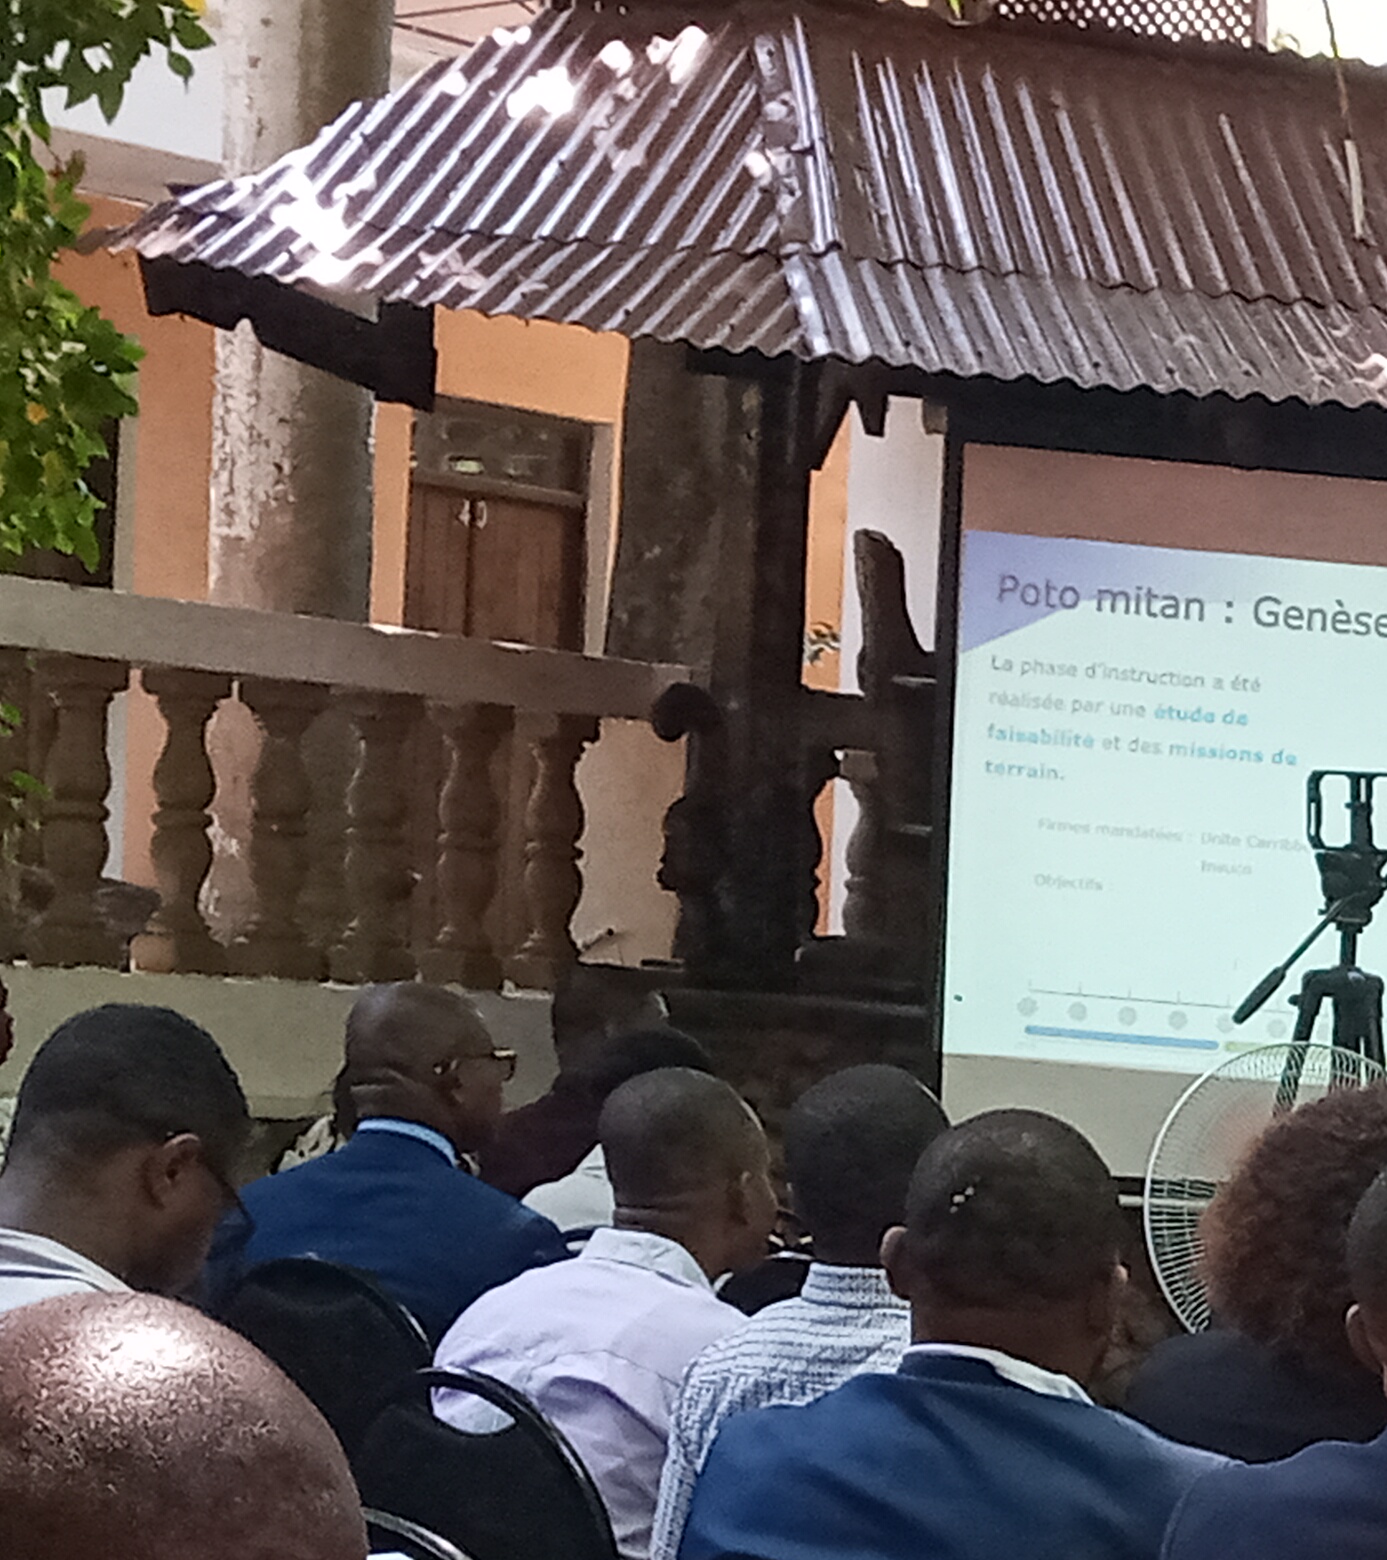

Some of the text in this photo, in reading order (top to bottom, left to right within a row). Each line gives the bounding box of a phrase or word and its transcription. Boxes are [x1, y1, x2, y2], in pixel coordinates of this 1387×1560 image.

[997, 574, 1080, 610] Poto
[1095, 586, 1205, 621] mitan
[991, 654, 1261, 692] La phase d'instruction a été
[988, 690, 1249, 727] réalisée par une étude de
[986, 722, 1298, 766] faisabilité et des missions de
[985, 759, 1065, 780] terrain.
